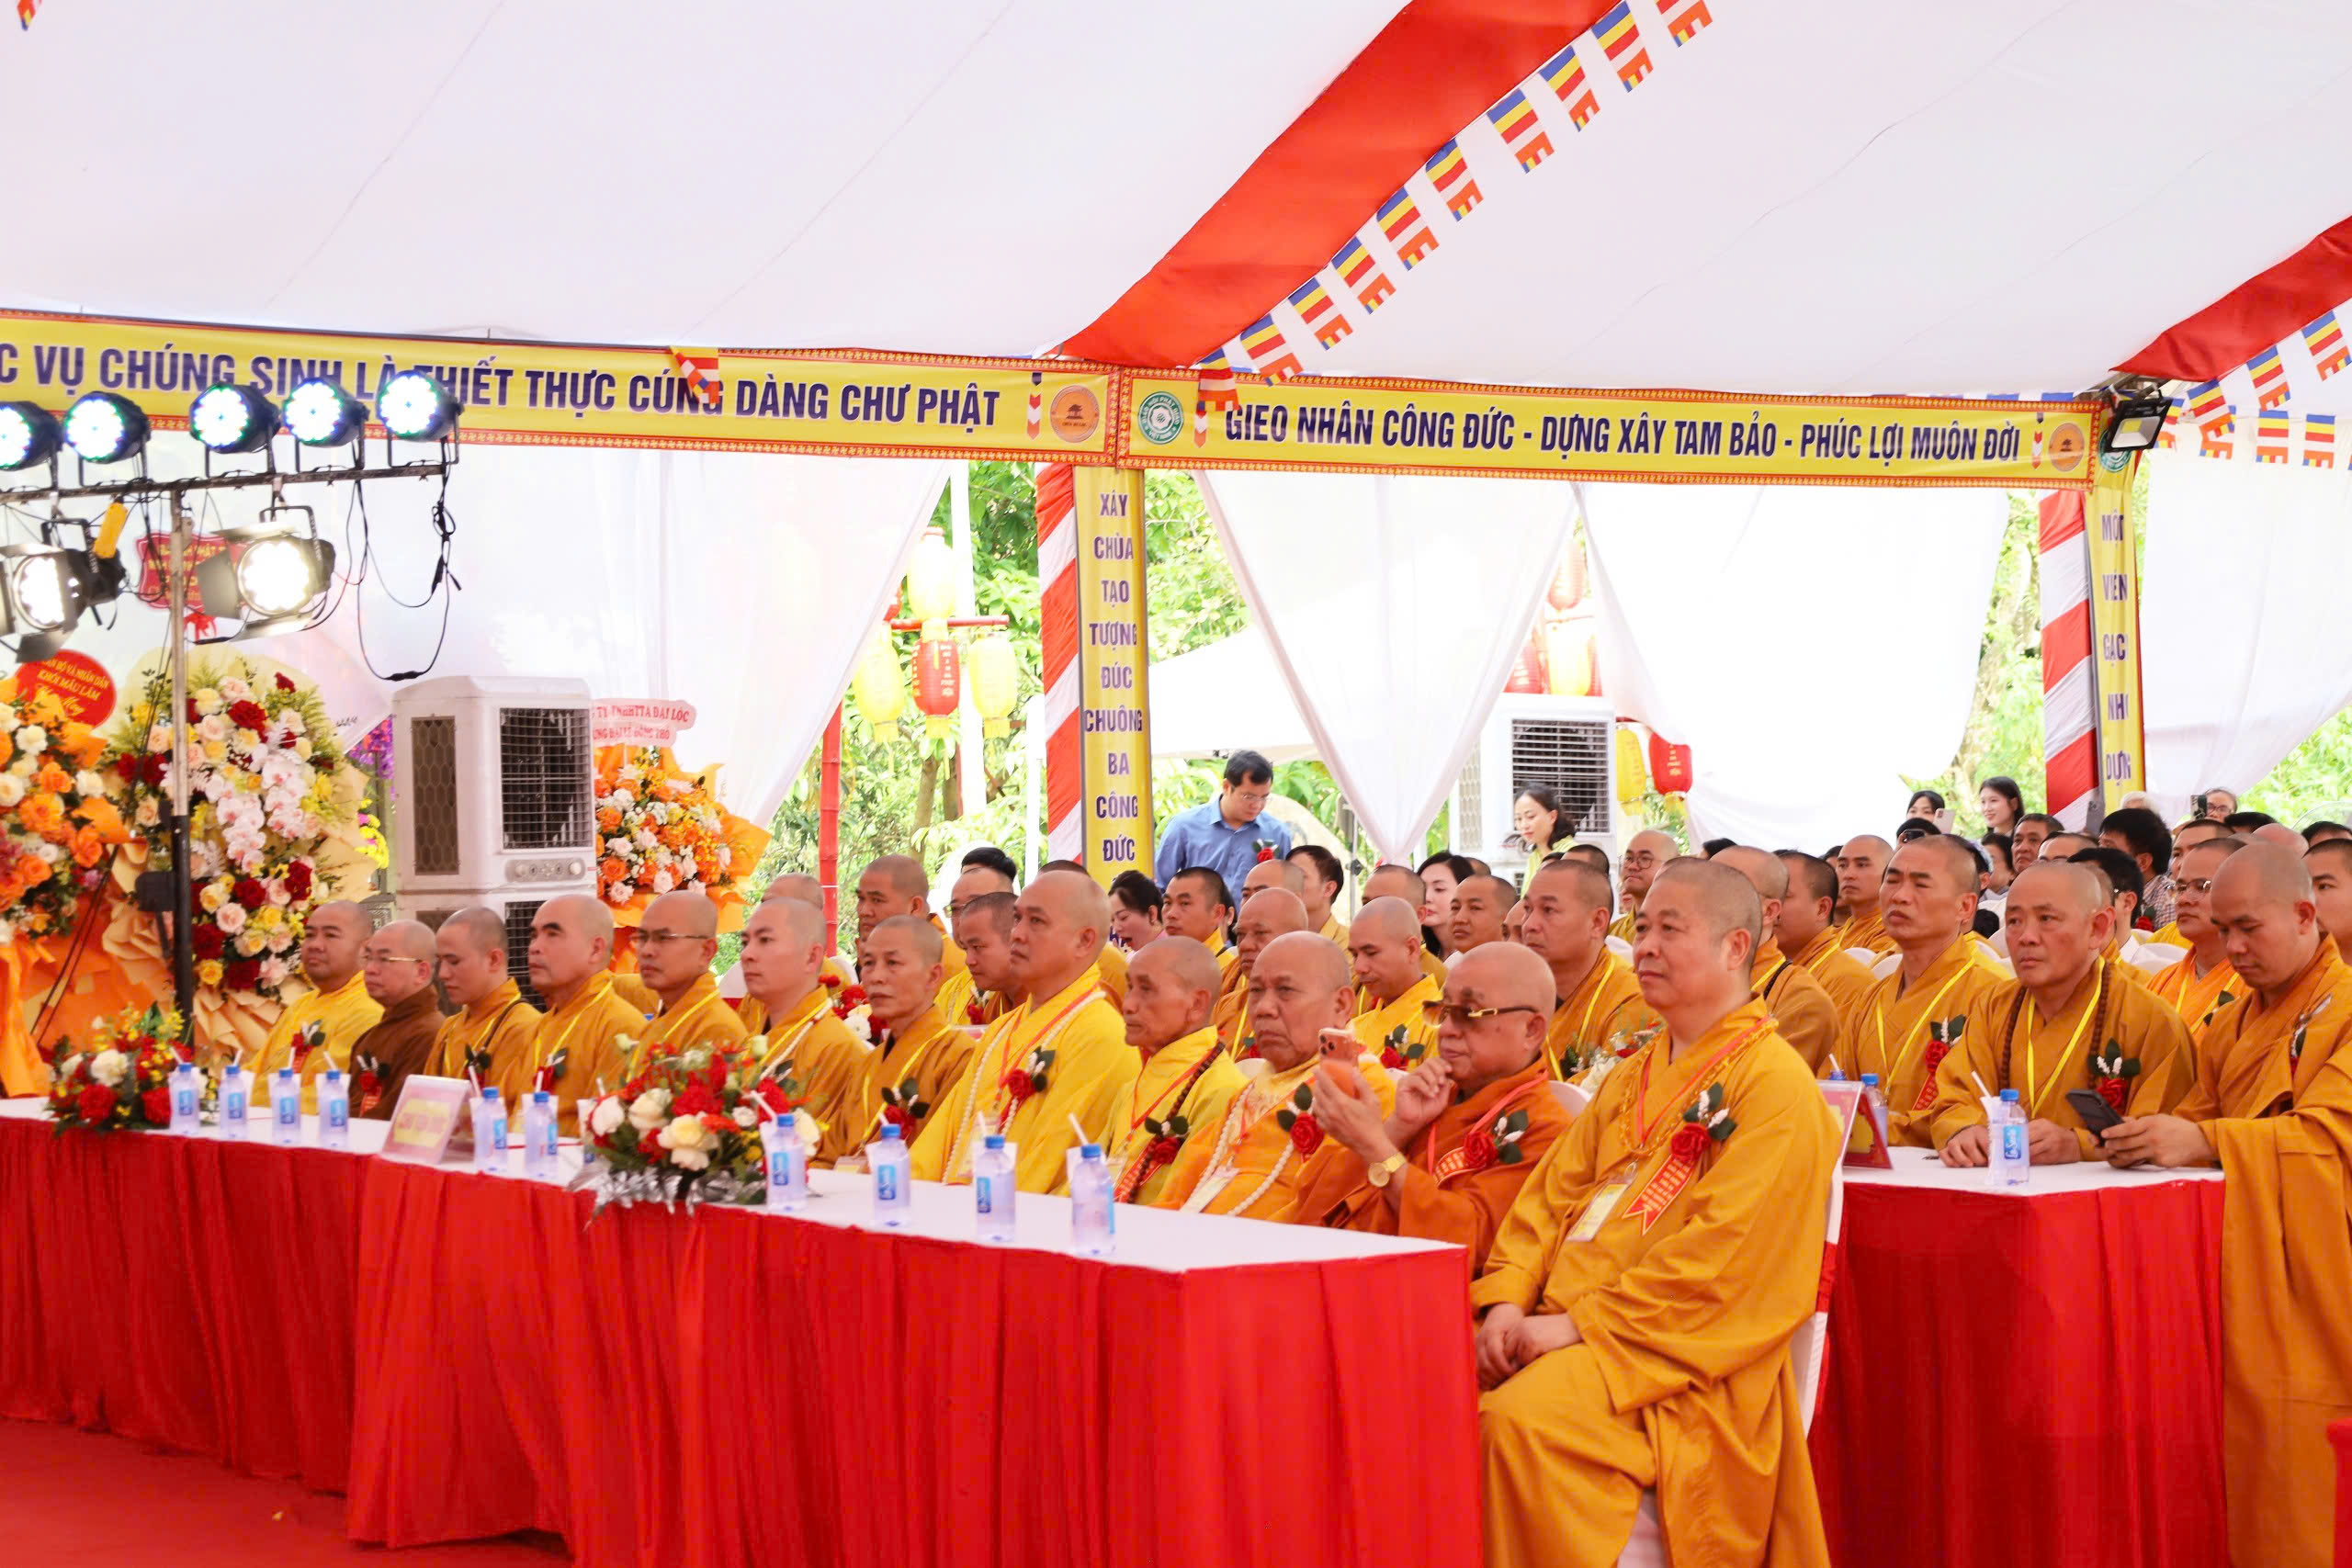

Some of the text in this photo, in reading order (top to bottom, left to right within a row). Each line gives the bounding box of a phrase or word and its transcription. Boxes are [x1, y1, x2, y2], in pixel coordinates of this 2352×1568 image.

[34, 345, 85, 396] VỤ
[100, 343, 236, 392] CHÚNG
[526, 369, 616, 418] THỰC
[736, 373, 829, 419] DÀNG
[841, 383, 911, 423] CHƯ
[916, 382, 1001, 434] PHẬT
[1226, 404, 1287, 443] GIEO
[1296, 400, 1374, 446] NHÂN
[1382, 403, 1455, 449] CÔNG
[1462, 406, 1515, 450] ĐỨC
[1541, 413, 1611, 460] DỰNG
[1617, 412, 1667, 454] XÂY
[1674, 421, 1723, 456] TAM
[1728, 411, 1777, 457] BẢO
[1800, 417, 1863, 459] PHÚC
[1869, 423, 1905, 468] LỢI
[1910, 420, 1977, 460] MUÔN
[1983, 421, 2021, 462] ĐỜI
[1101, 580, 1130, 608] TẠO
[1101, 661, 1133, 689] ĐÚC
[1084, 705, 1143, 732] CHUÔNG
[1108, 752, 1130, 775] BA
[1096, 791, 1138, 818] CÔNG
[1102, 834, 1136, 862] ĐỨC
